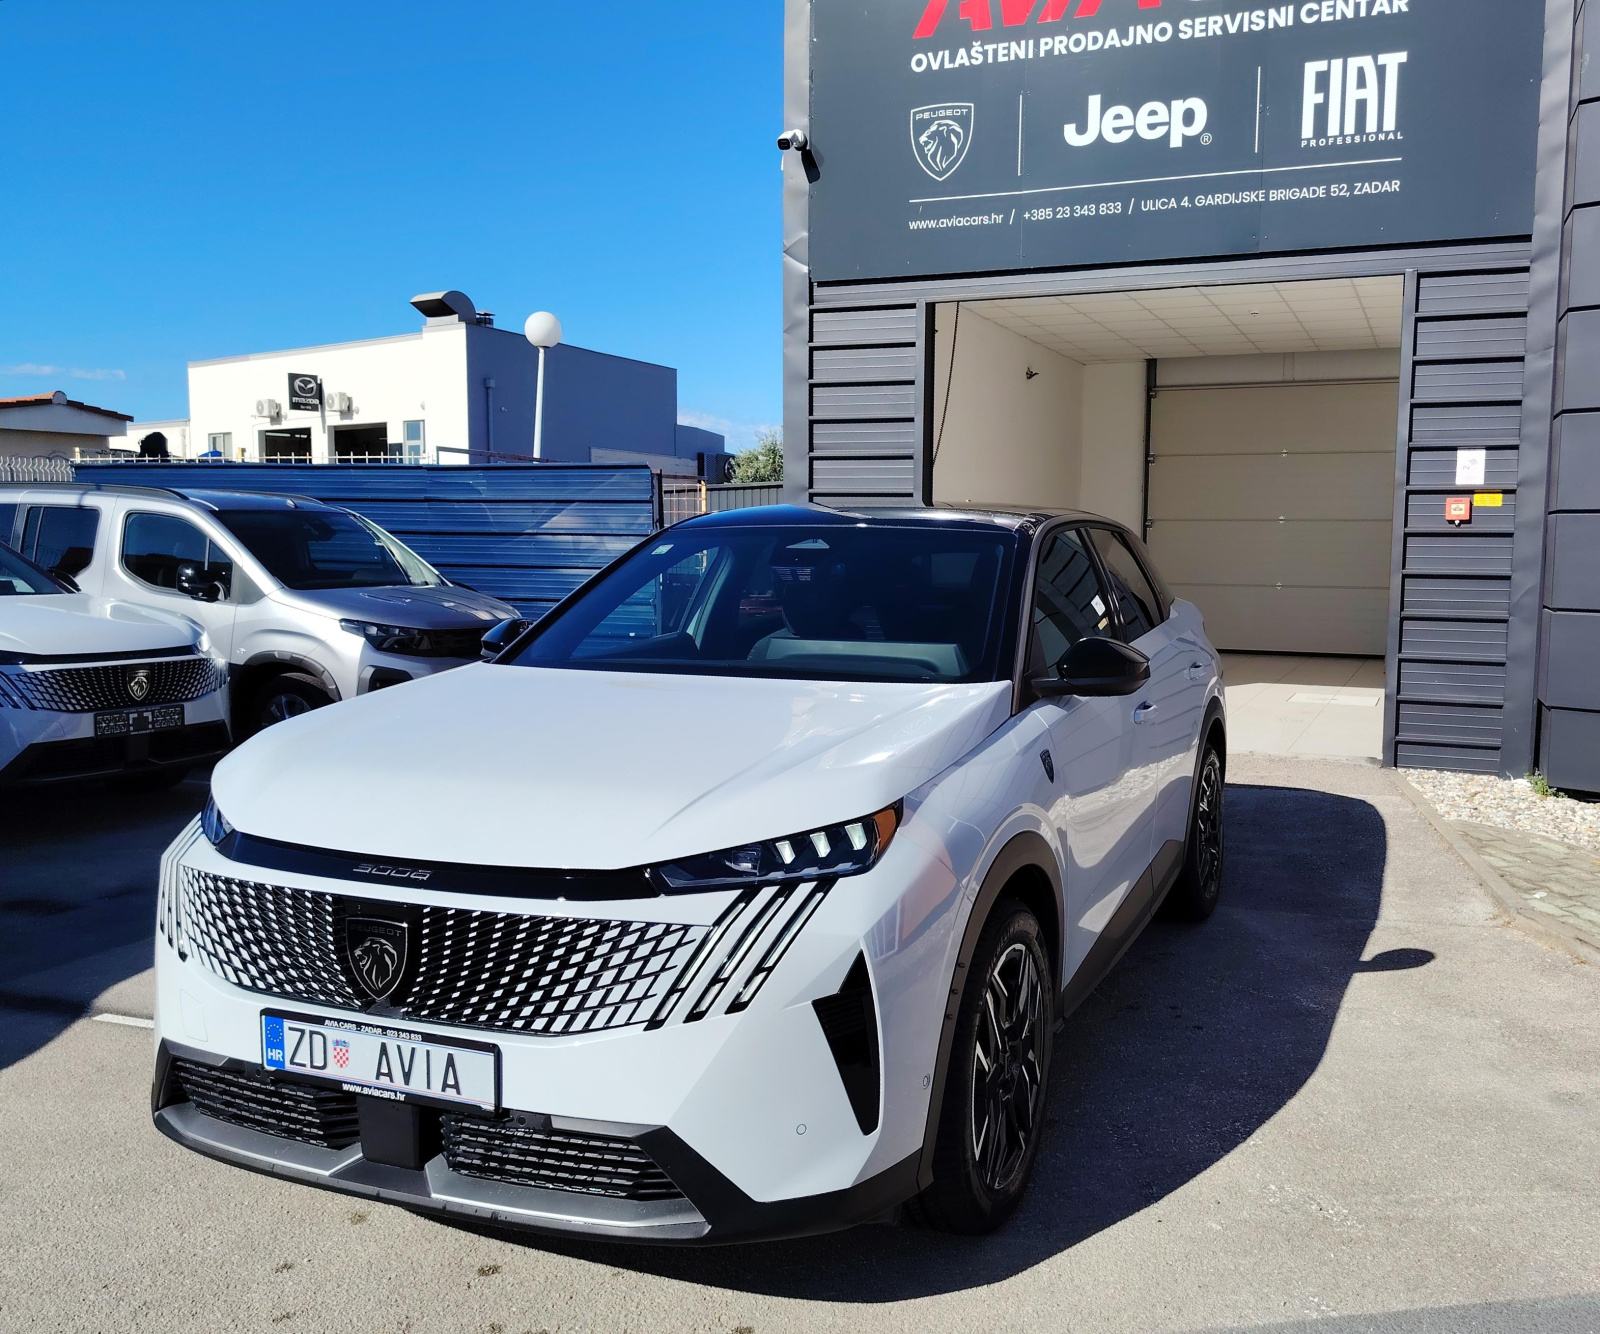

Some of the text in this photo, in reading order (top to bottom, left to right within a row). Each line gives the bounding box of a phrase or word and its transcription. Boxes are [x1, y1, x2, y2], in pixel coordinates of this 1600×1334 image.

[910, 41, 1034, 73] OVLAŠTENI
[1039, 23, 1172, 57] PRODAJNO
[1178, 5, 1294, 40] SERVISNI
[1300, 0, 1409, 24] CENTAR
[1301, 51, 1408, 139] FIAT
[915, 108, 969, 121] PEUGEOT
[1063, 94, 1208, 149] Jeep
[1300, 131, 1404, 148] PROFESSIONAL
[908, 212, 1004, 230] www.aviacars.hr
[1023, 208, 1053, 222] +385
[1055, 206, 1071, 219] 23
[1073, 204, 1097, 217] 343
[1099, 202, 1122, 215] 833
[1141, 197, 1178, 213] ULICA
[1180, 195, 1192, 209] 4.
[1194, 190, 1266, 208] GARDIJSKE
[1269, 186, 1327, 202] BRIGADE
[1330, 183, 1351, 198] 52,
[1353, 180, 1401, 196] ZADAR
[324, 1020, 339, 1028] AVIA
[339, 1021, 357, 1030] CARS
[360, 1025, 383, 1034] ZADAR
[386, 1029, 399, 1038] 023
[267, 1047, 284, 1062] HR
[287, 1026, 462, 1096] ZD AVIA
[342, 1083, 406, 1102] www.aviacars.hr
